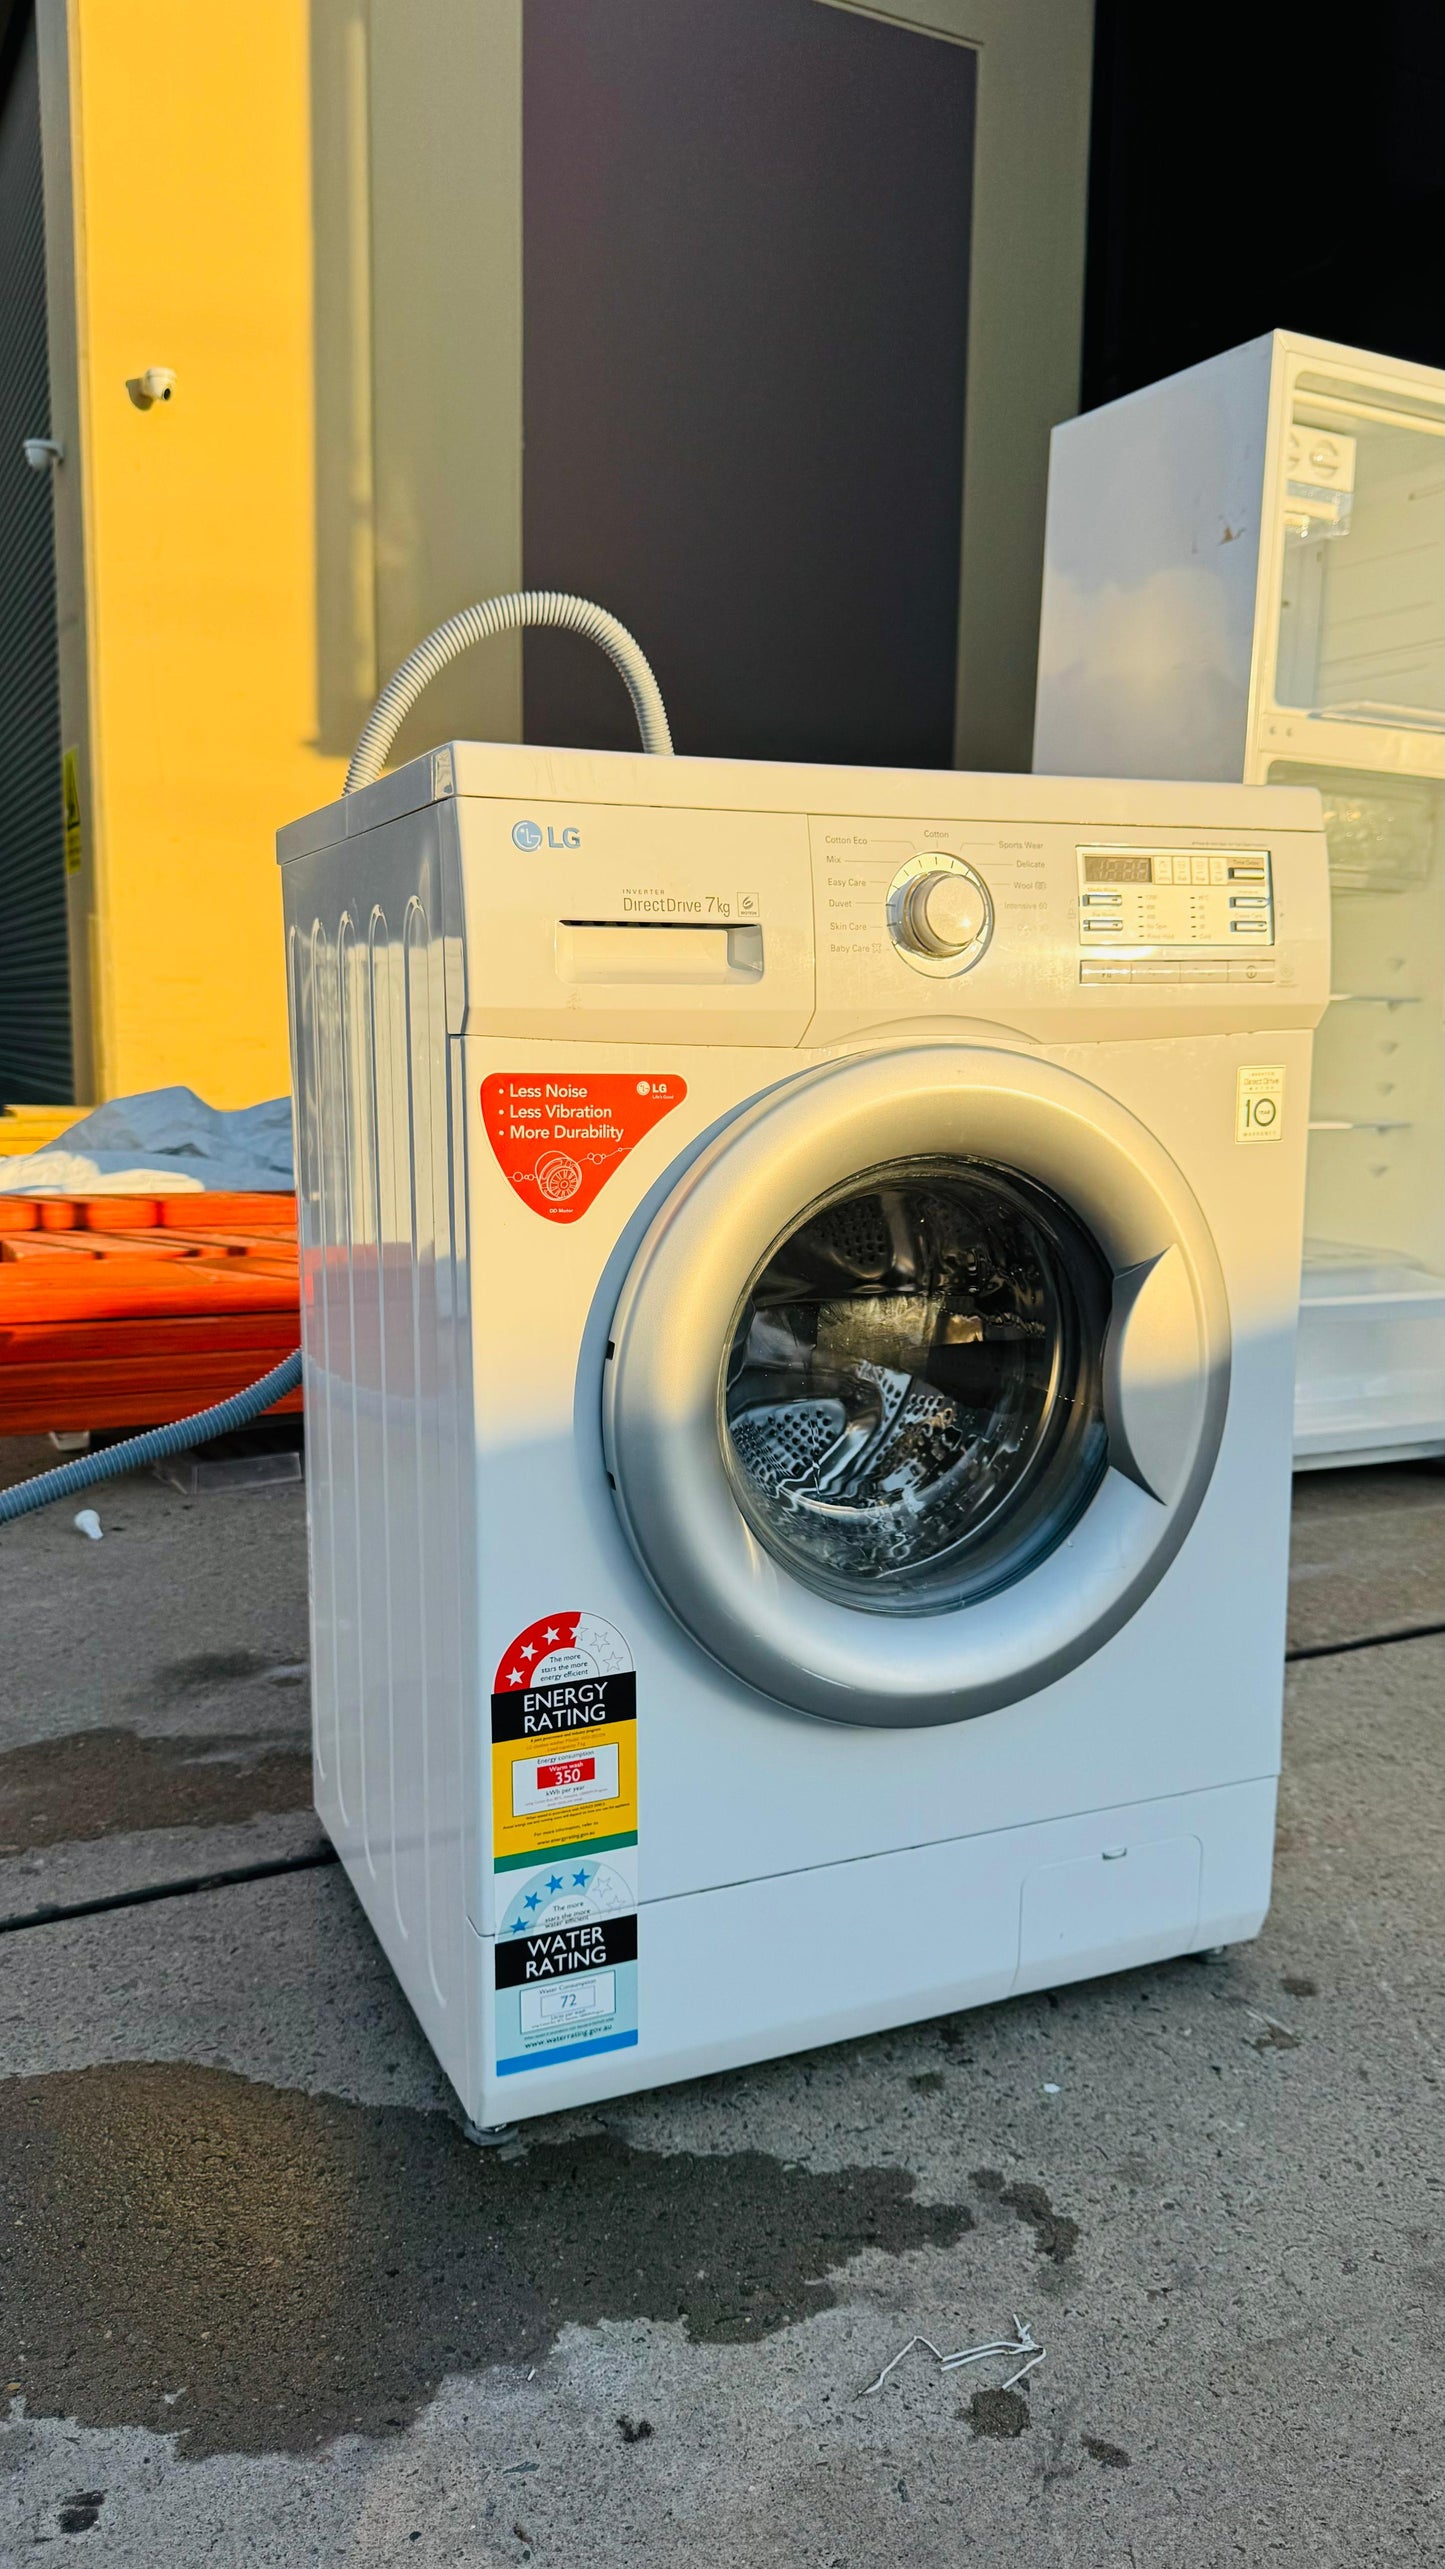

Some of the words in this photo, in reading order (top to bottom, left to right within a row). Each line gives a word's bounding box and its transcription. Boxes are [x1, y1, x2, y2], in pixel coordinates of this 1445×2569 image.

[548, 826, 581, 849] LG
[923, 830, 950, 838] Cotton
[825, 836, 852, 844] Cotton
[854, 836, 868, 845] Eco
[998, 840, 1023, 850] Sports
[1024, 841, 1044, 850] Wear
[826, 856, 842, 864] Mix
[1016, 860, 1046, 868] Delicate
[828, 878, 847, 888] Easy
[848, 878, 866, 887] Care
[1013, 881, 1033, 890] Wool
[622, 888, 666, 896] INVERTER
[704, 896, 731, 917] 7kg
[828, 900, 852, 908] Duvet
[830, 922, 848, 930] Skin
[850, 922, 868, 931] Care
[830, 944, 848, 953] Baby
[850, 944, 870, 952] Care
[510, 1084, 542, 1098] Less
[546, 1084, 588, 1098] Noise
[652, 1083, 668, 1093] LG
[510, 1104, 542, 1118] Less
[545, 1104, 612, 1118] Vibration
[1246, 1098, 1276, 1127] 10
[510, 1125, 550, 1139] More
[554, 1124, 624, 1142] Durability
[550, 1656, 562, 1664] The
[563, 1654, 581, 1662] more
[541, 1666, 557, 1674] stars
[558, 1664, 570, 1672] the
[570, 1662, 588, 1670] more
[540, 1673, 562, 1682] energy
[563, 1669, 588, 1678] efficient
[523, 1682, 608, 1713] ENERGY
[524, 1703, 606, 1734] RATING
[537, 1756, 557, 1765] Energy
[558, 1750, 594, 1762] consumption
[549, 1764, 568, 1772] Warm
[570, 1761, 584, 1769] wash
[555, 1768, 581, 1786] 350
[546, 1788, 560, 1796] kWh
[562, 1787, 572, 1796] per
[574, 1785, 585, 1794] year
[553, 1904, 565, 1912] The
[566, 1902, 584, 1910] more
[545, 1920, 564, 1928] water
[565, 1914, 589, 1924] efficient
[527, 1926, 605, 1958] WATER
[526, 1946, 607, 1979] RATING
[539, 1986, 557, 1994] Water
[559, 1979, 597, 1991] Consumption
[560, 1994, 577, 2009] 72
[524, 2024, 613, 2049] www.waterrating.gov.au
